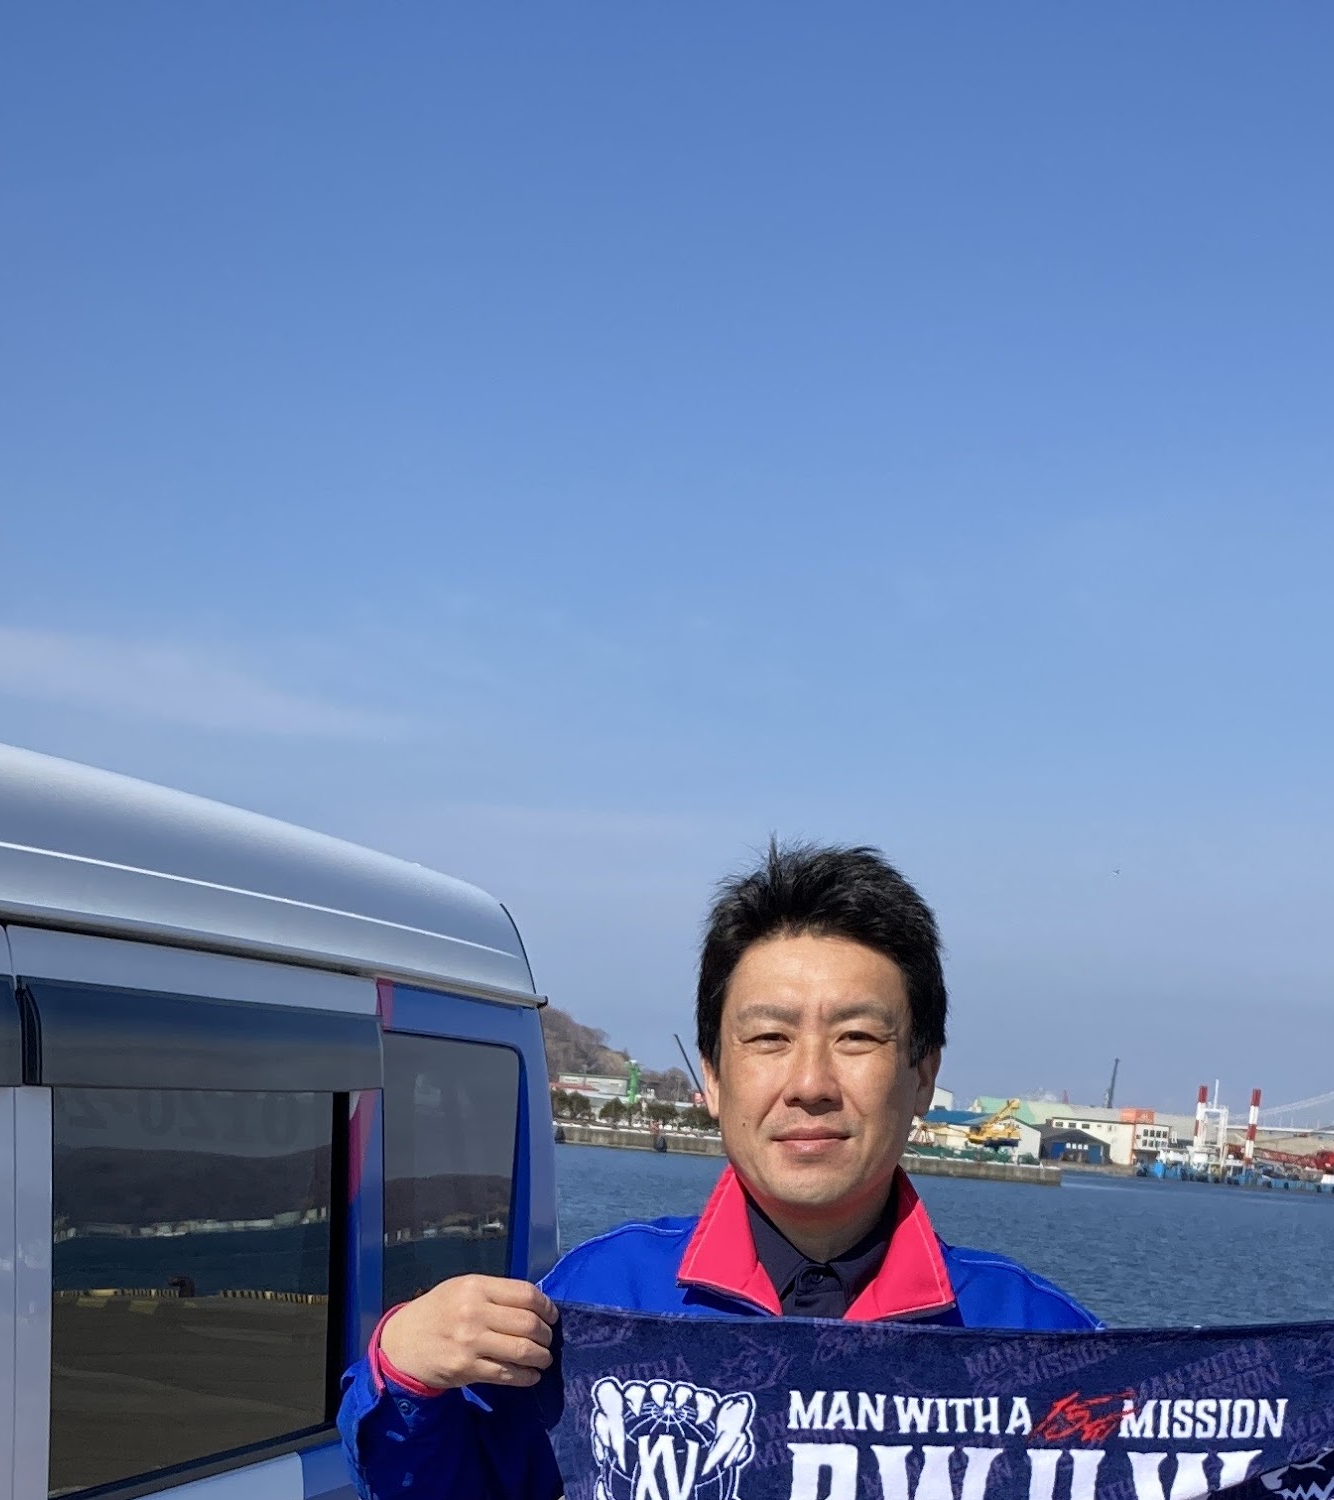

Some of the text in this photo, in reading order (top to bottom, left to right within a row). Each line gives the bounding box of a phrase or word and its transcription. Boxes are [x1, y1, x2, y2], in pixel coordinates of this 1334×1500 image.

[787, 1390, 886, 1432] MAN
[893, 1395, 999, 1434] WITH
[1005, 1396, 1032, 1435] A
[1118, 1398, 1288, 1438] MISSION
